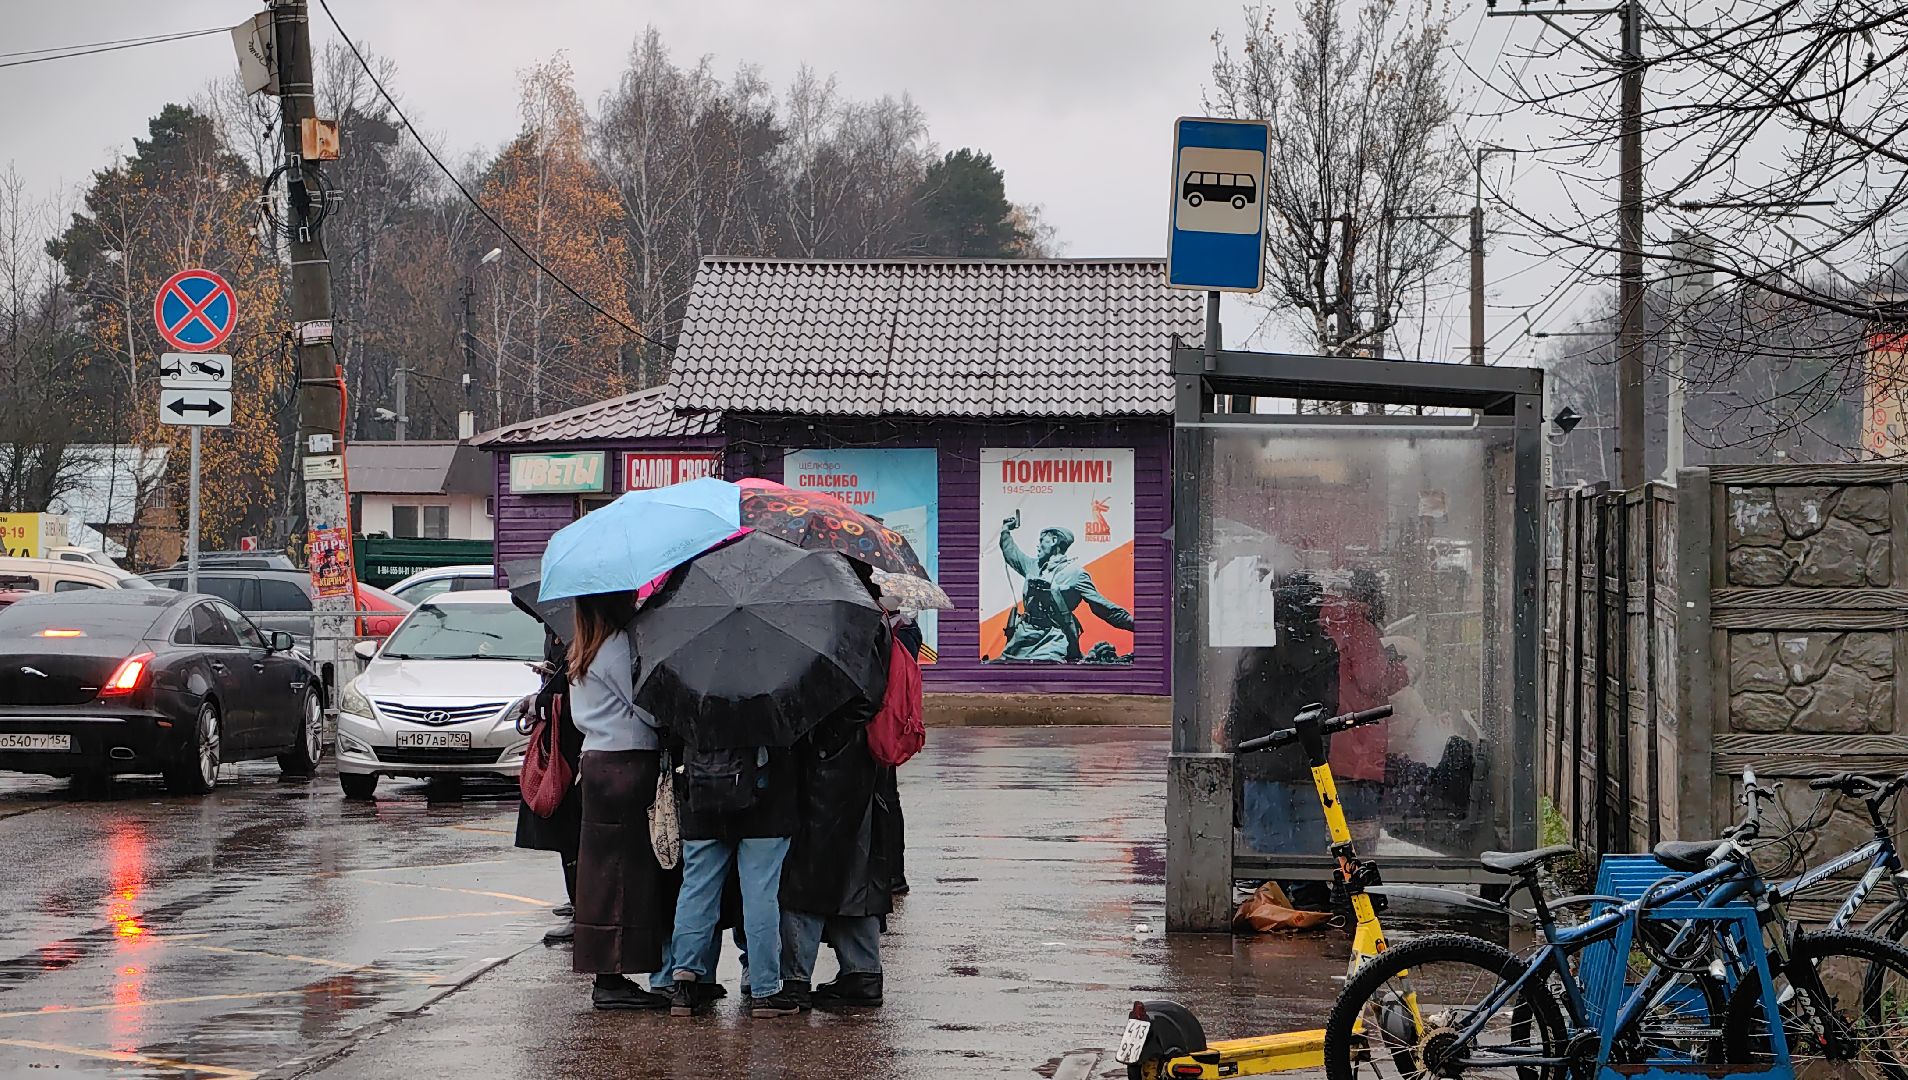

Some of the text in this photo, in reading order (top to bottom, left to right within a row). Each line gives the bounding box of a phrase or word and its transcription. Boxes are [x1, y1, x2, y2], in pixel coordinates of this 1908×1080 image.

[516, 456, 600, 489] ЦВЕТЫ
[631, 458, 672, 488] САЛОН
[1002, 459, 1113, 484] ПОМНИМ!
[799, 474, 858, 488] СПАСИБО
[312, 539, 346, 553] ЦИРК
[49, 735, 67, 745] 154
[449, 733, 467, 743] 750
